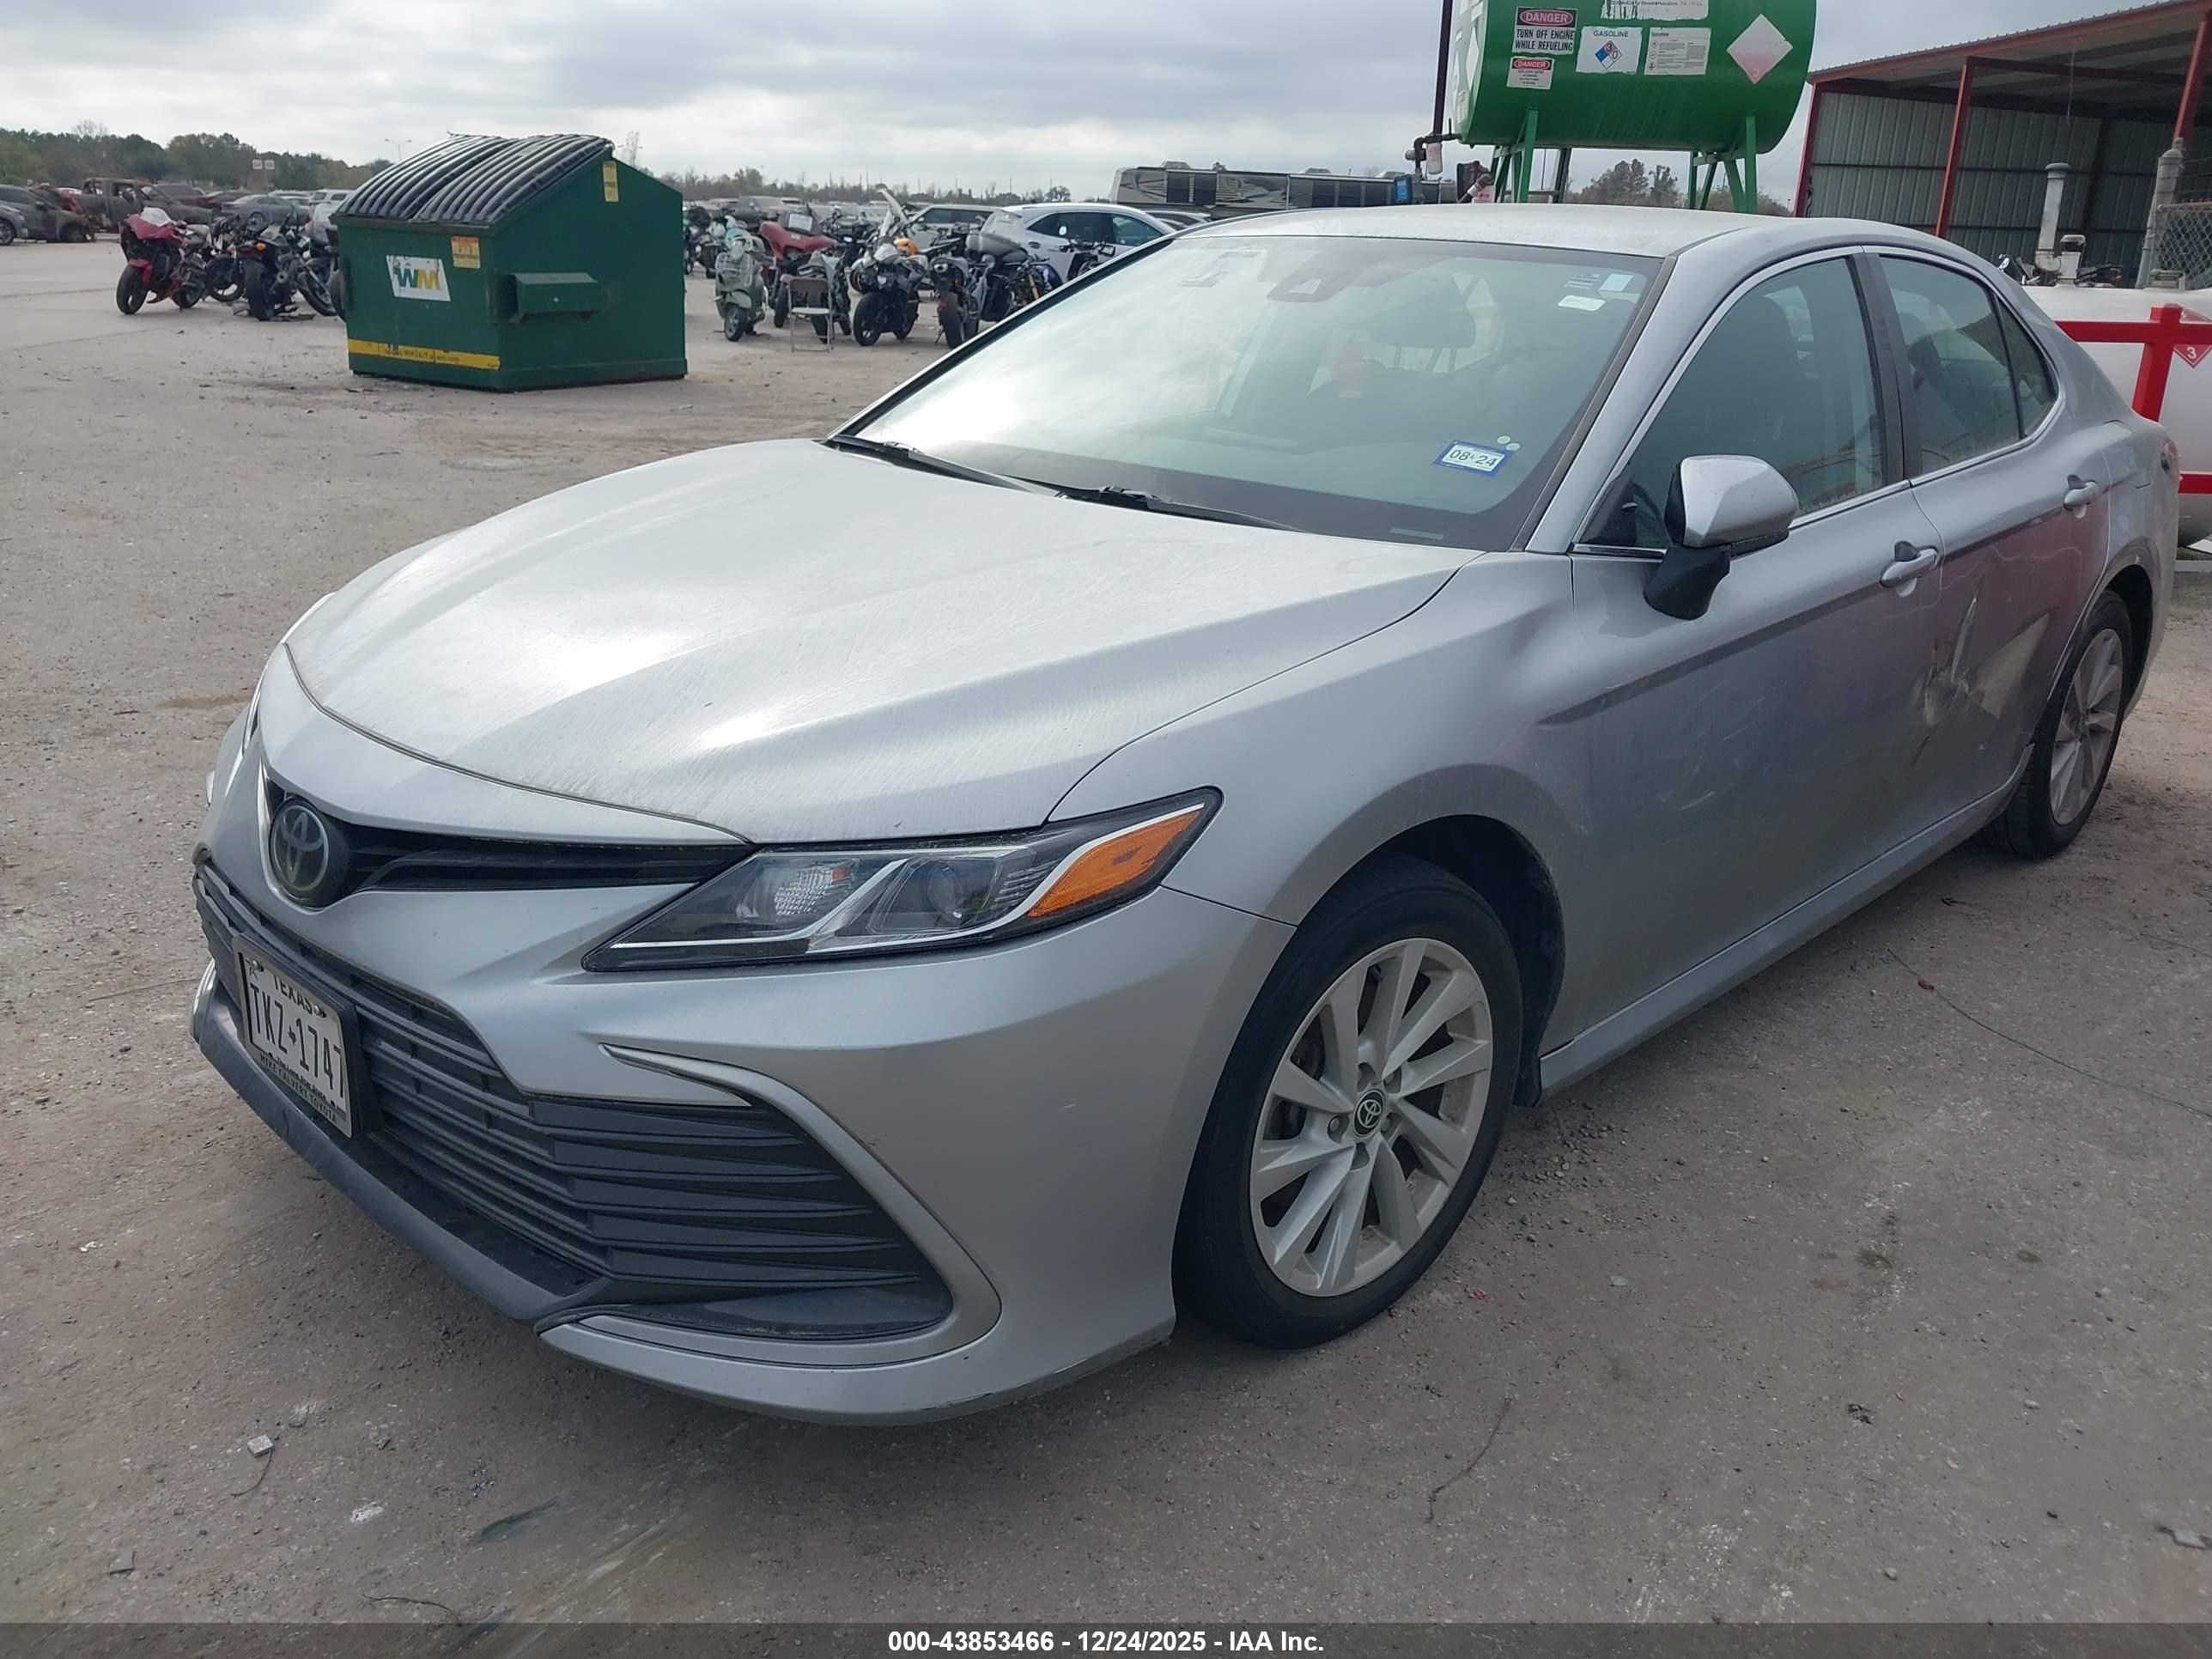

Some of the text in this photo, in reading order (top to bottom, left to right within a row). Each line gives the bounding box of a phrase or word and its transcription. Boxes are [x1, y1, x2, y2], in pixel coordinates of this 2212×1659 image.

[1525, 12, 1568, 23] DANGER
[1516, 28, 1576, 40] TURN OFF ENGINE
[1516, 40, 1573, 52] WHILE REFUELING
[1606, 42, 1613, 52] 3
[1612, 51, 1619, 59] 0
[398, 268, 440, 289] WM
[2186, 346, 2197, 359] 3
[1449, 449, 1498, 467] 08 24
[273, 975, 313, 1016] TEXAS
[259, 1050, 337, 1124] MIKE CALVERT TOYOTA
